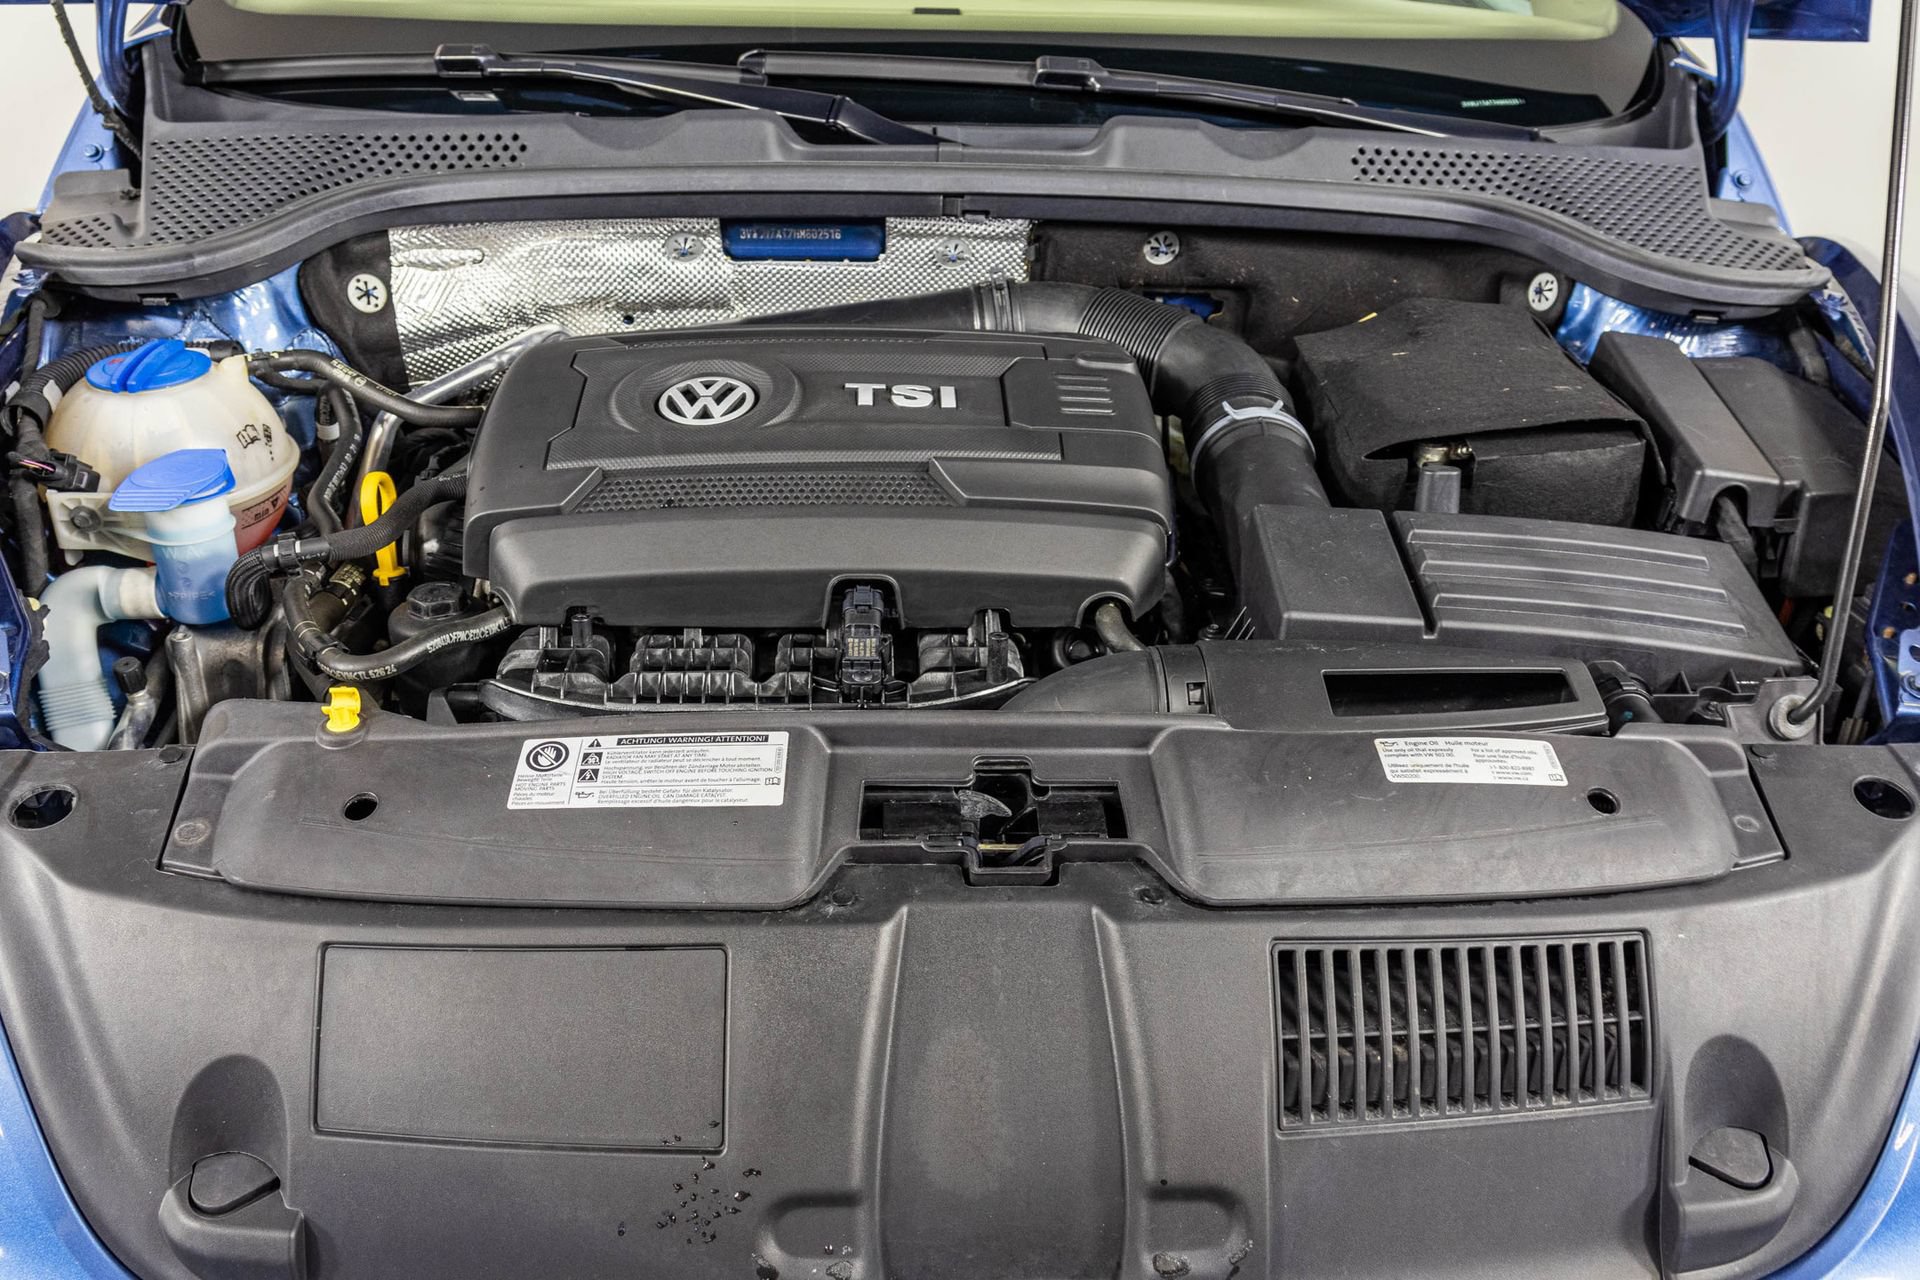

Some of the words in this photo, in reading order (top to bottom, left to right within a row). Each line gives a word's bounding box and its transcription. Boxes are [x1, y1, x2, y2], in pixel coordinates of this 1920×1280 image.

[659, 376, 755, 425] VW
[845, 382, 957, 409] TSI
[620, 737, 666, 745] ACHTUNG!
